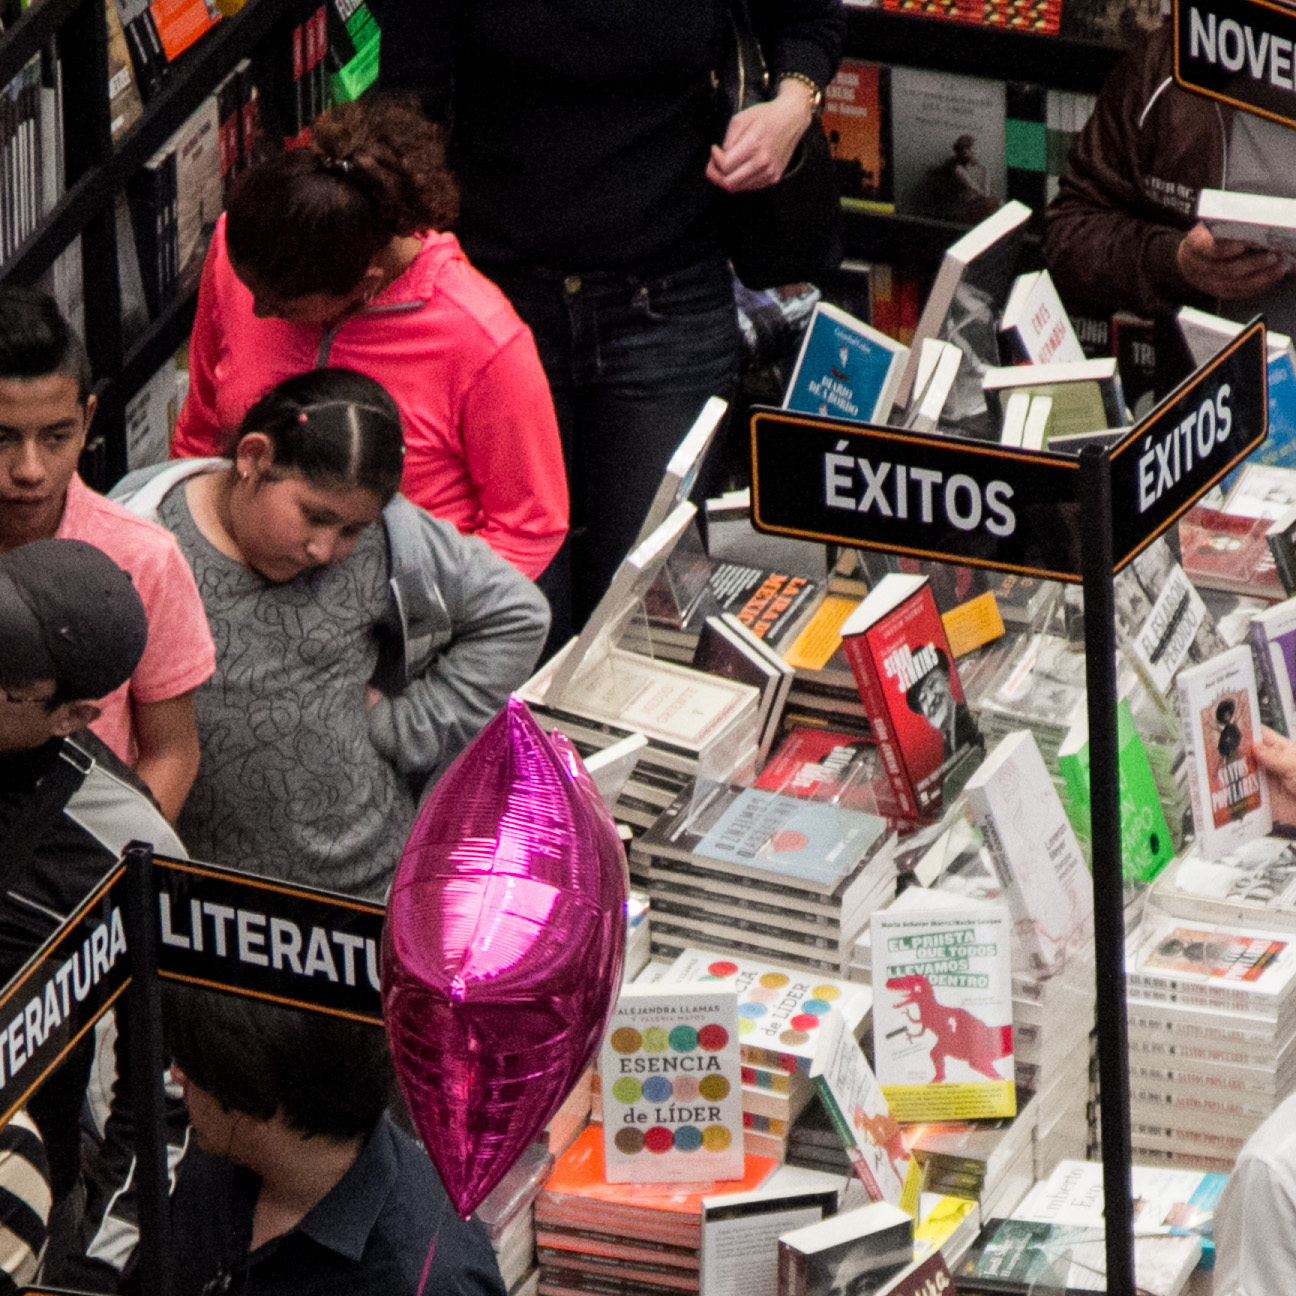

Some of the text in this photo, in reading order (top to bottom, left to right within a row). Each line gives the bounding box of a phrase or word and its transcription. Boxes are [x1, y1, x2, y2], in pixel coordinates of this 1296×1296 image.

[1137, 384, 1233, 514] ÉXITOS
[825, 440, 1016, 537] ÉXITOS
[888, 931, 975, 951] EL PRIISTA
[917, 945, 996, 958] QUE TODOS
[887, 960, 968, 977] LLEVAMOS
[927, 974, 988, 988] DENTRO
[618, 1005, 720, 1016] ALEJANDRA LLAMAS
[761, 983, 810, 1037] de LÍDER
[619, 1056, 722, 1073] ESENCIA
[623, 1104, 722, 1124] de LÍDER
[1035, 1167, 1085, 1222] Umberto
[1072, 1184, 1103, 1209] Eco
